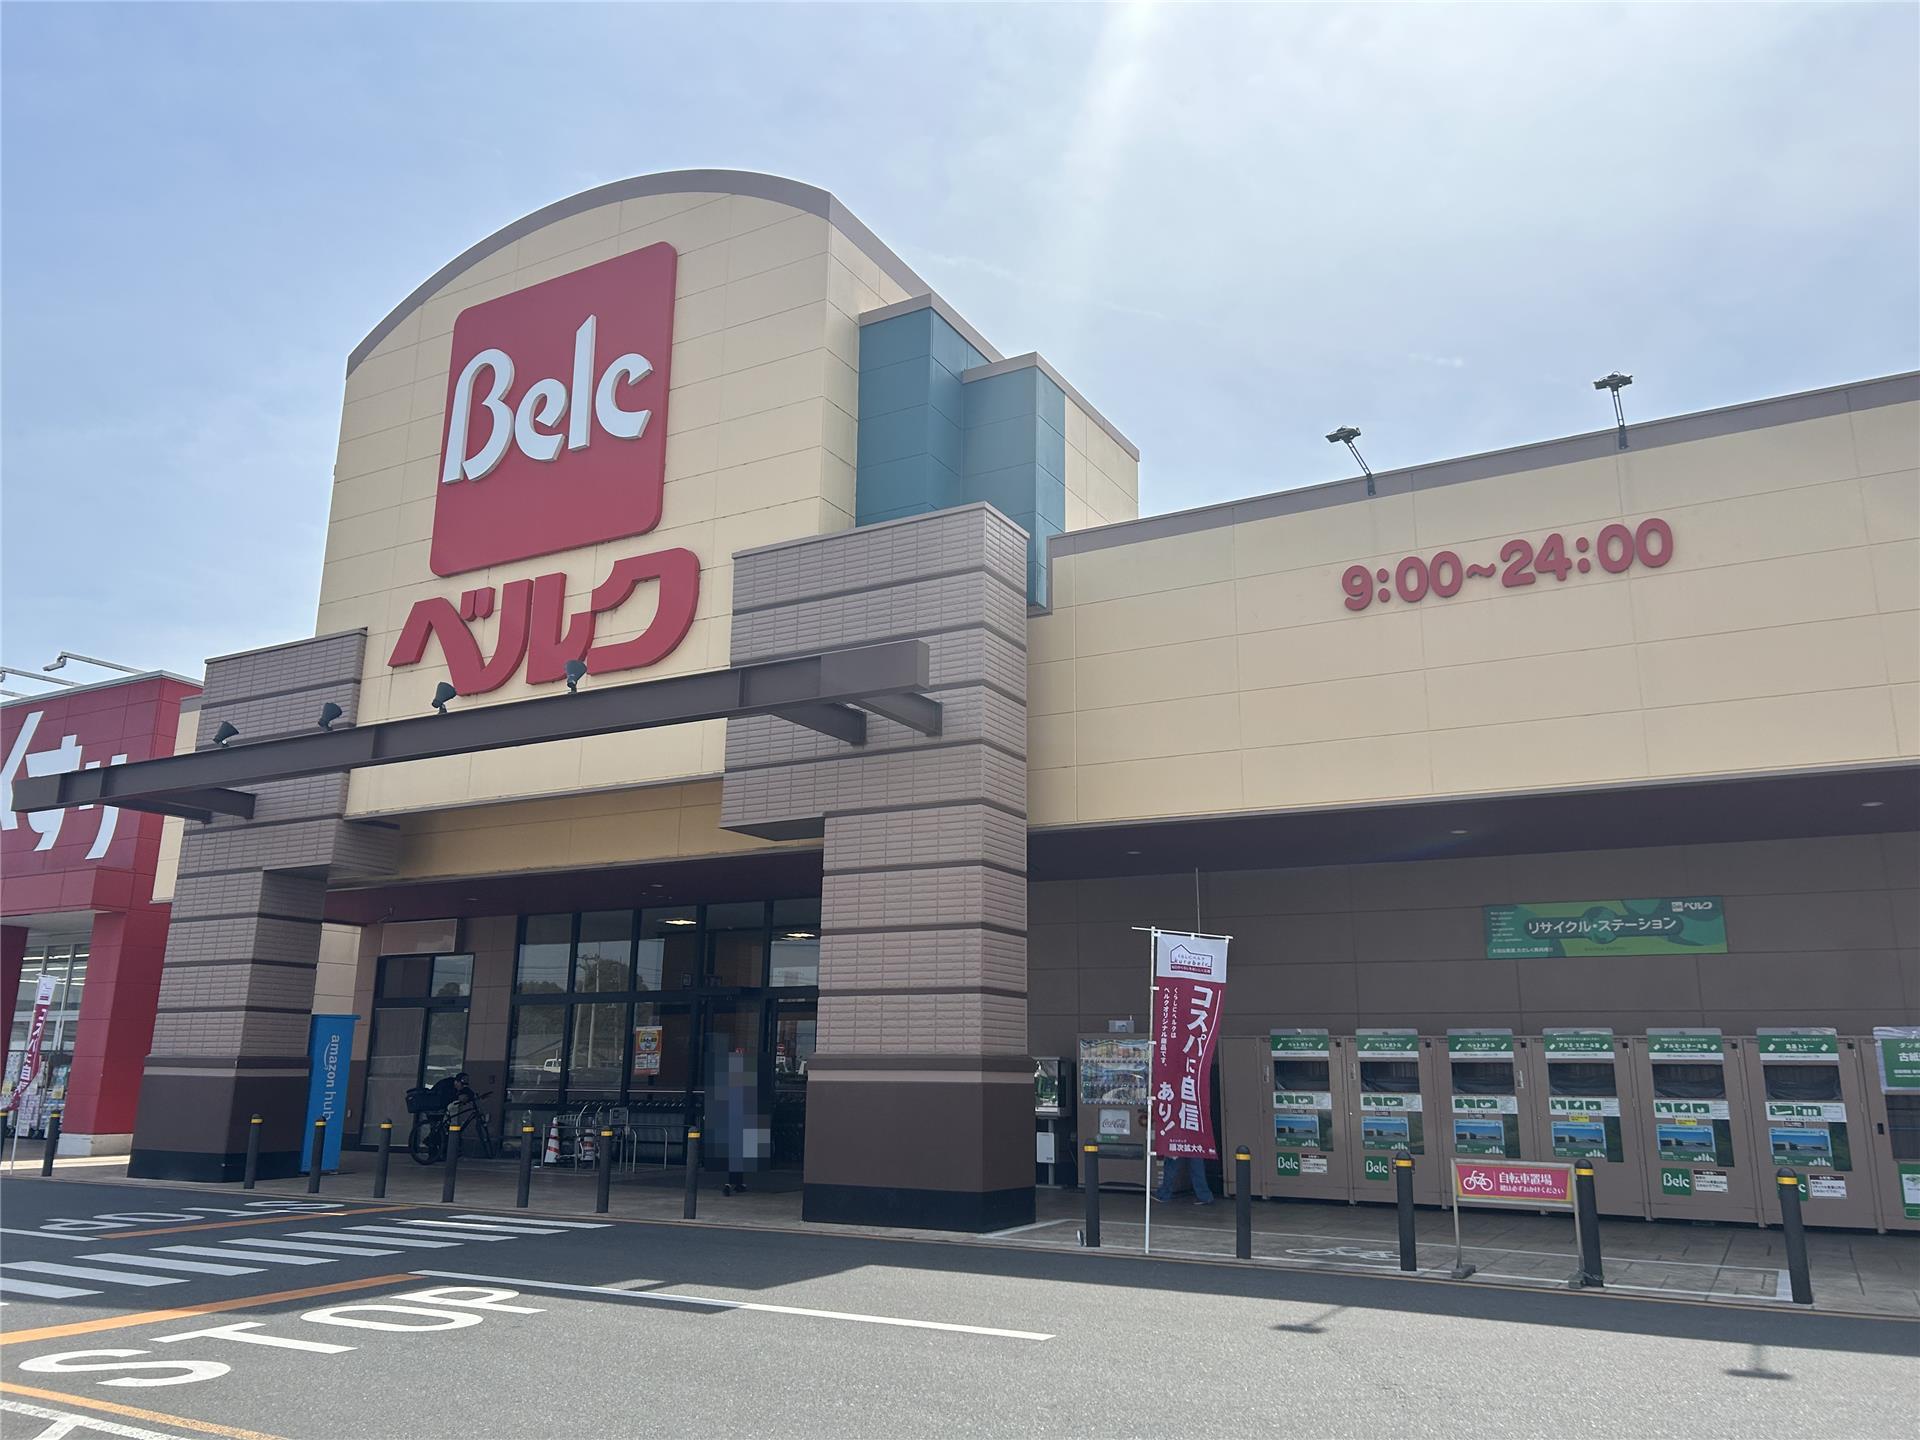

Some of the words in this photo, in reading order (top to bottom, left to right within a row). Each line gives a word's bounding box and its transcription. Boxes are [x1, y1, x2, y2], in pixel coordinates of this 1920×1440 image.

[442, 314, 654, 484] Belc
[387, 546, 700, 696] ベルク
[1684, 901, 1713, 911] ベルク
[1528, 917, 1677, 935] リサイクル・ステーション
[326, 1034, 341, 1088] amazon
[1178, 985, 1213, 1132] コスパに自信
[322, 1091, 337, 1120] hub
[1277, 1156, 1299, 1170] Belc
[1365, 1161, 1388, 1174] Belc
[1499, 1172, 1552, 1186] 自転車置場
[1663, 1173, 1690, 1188] Belc
[18, 1286, 547, 1387] STOP
